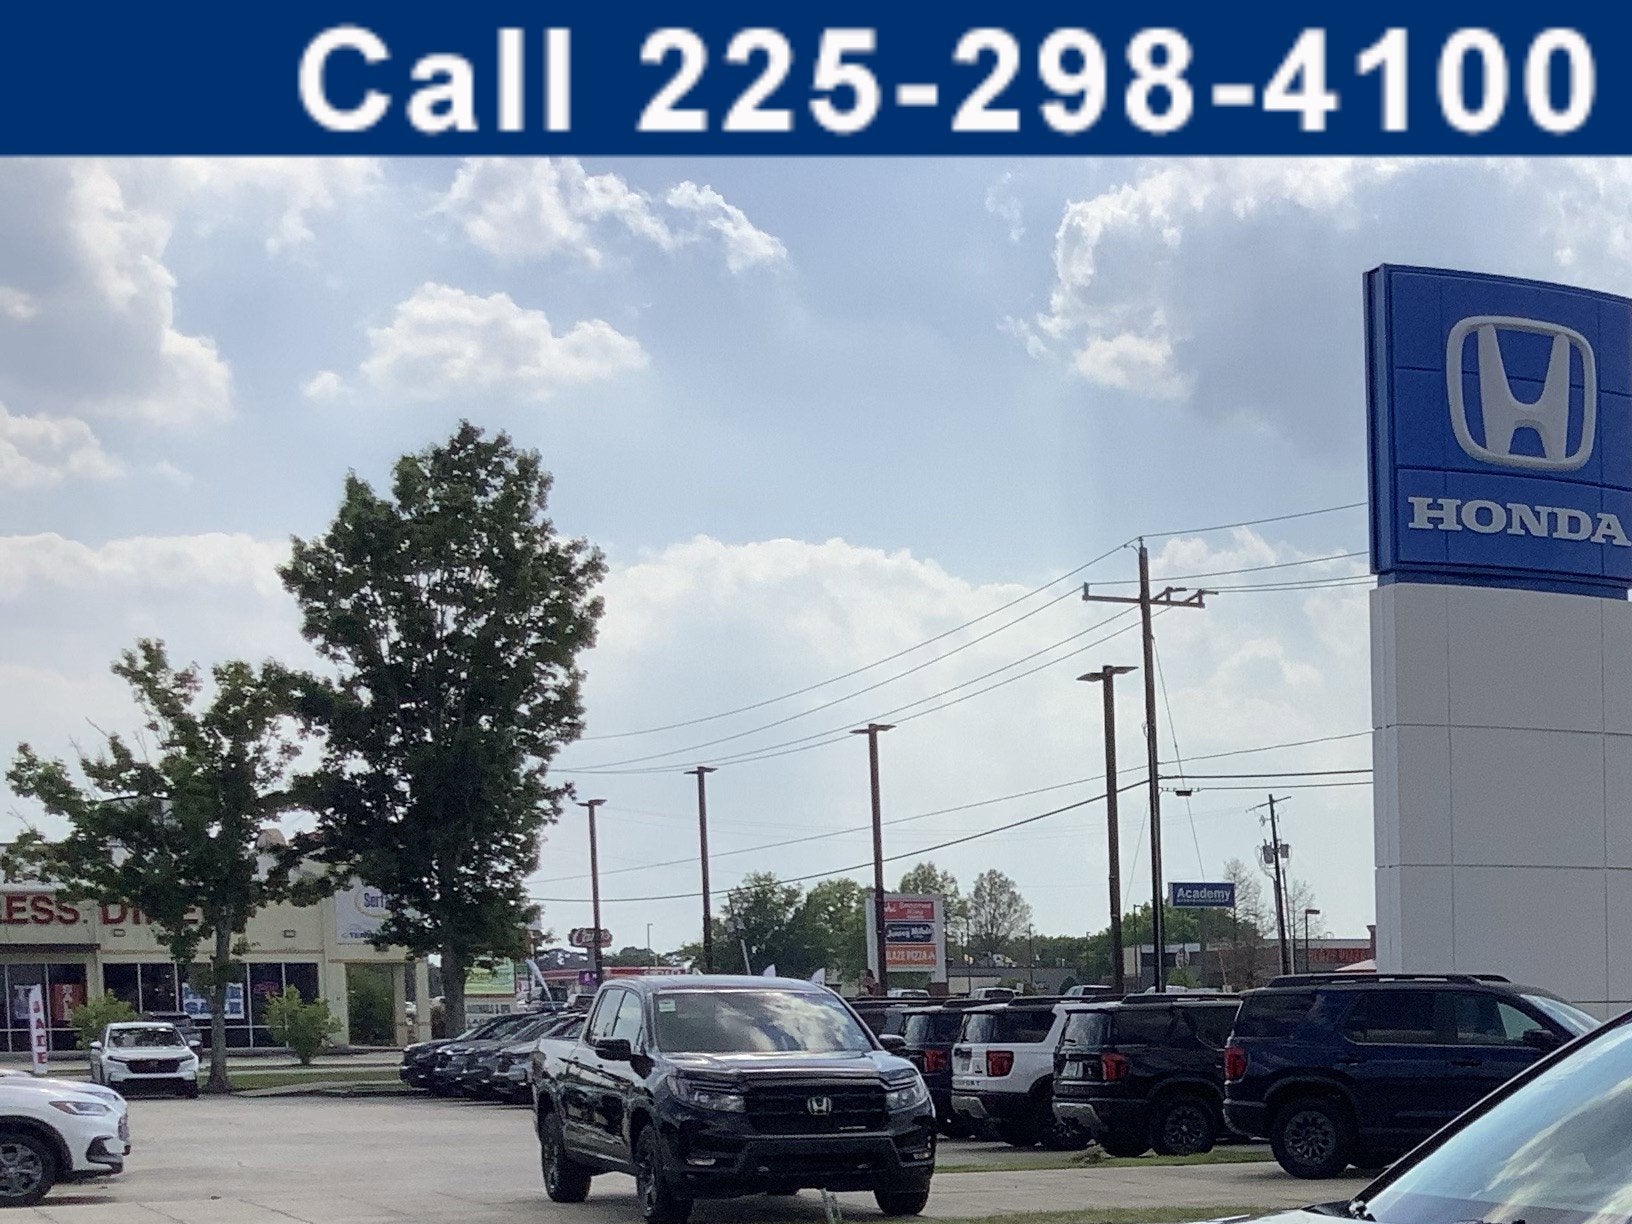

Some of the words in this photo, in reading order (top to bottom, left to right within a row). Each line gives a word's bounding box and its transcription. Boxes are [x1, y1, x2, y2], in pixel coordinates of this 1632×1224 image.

[1407, 496, 1632, 547] HONDA
[1177, 887, 1231, 901] Academy
[0, 895, 81, 926] ESS
